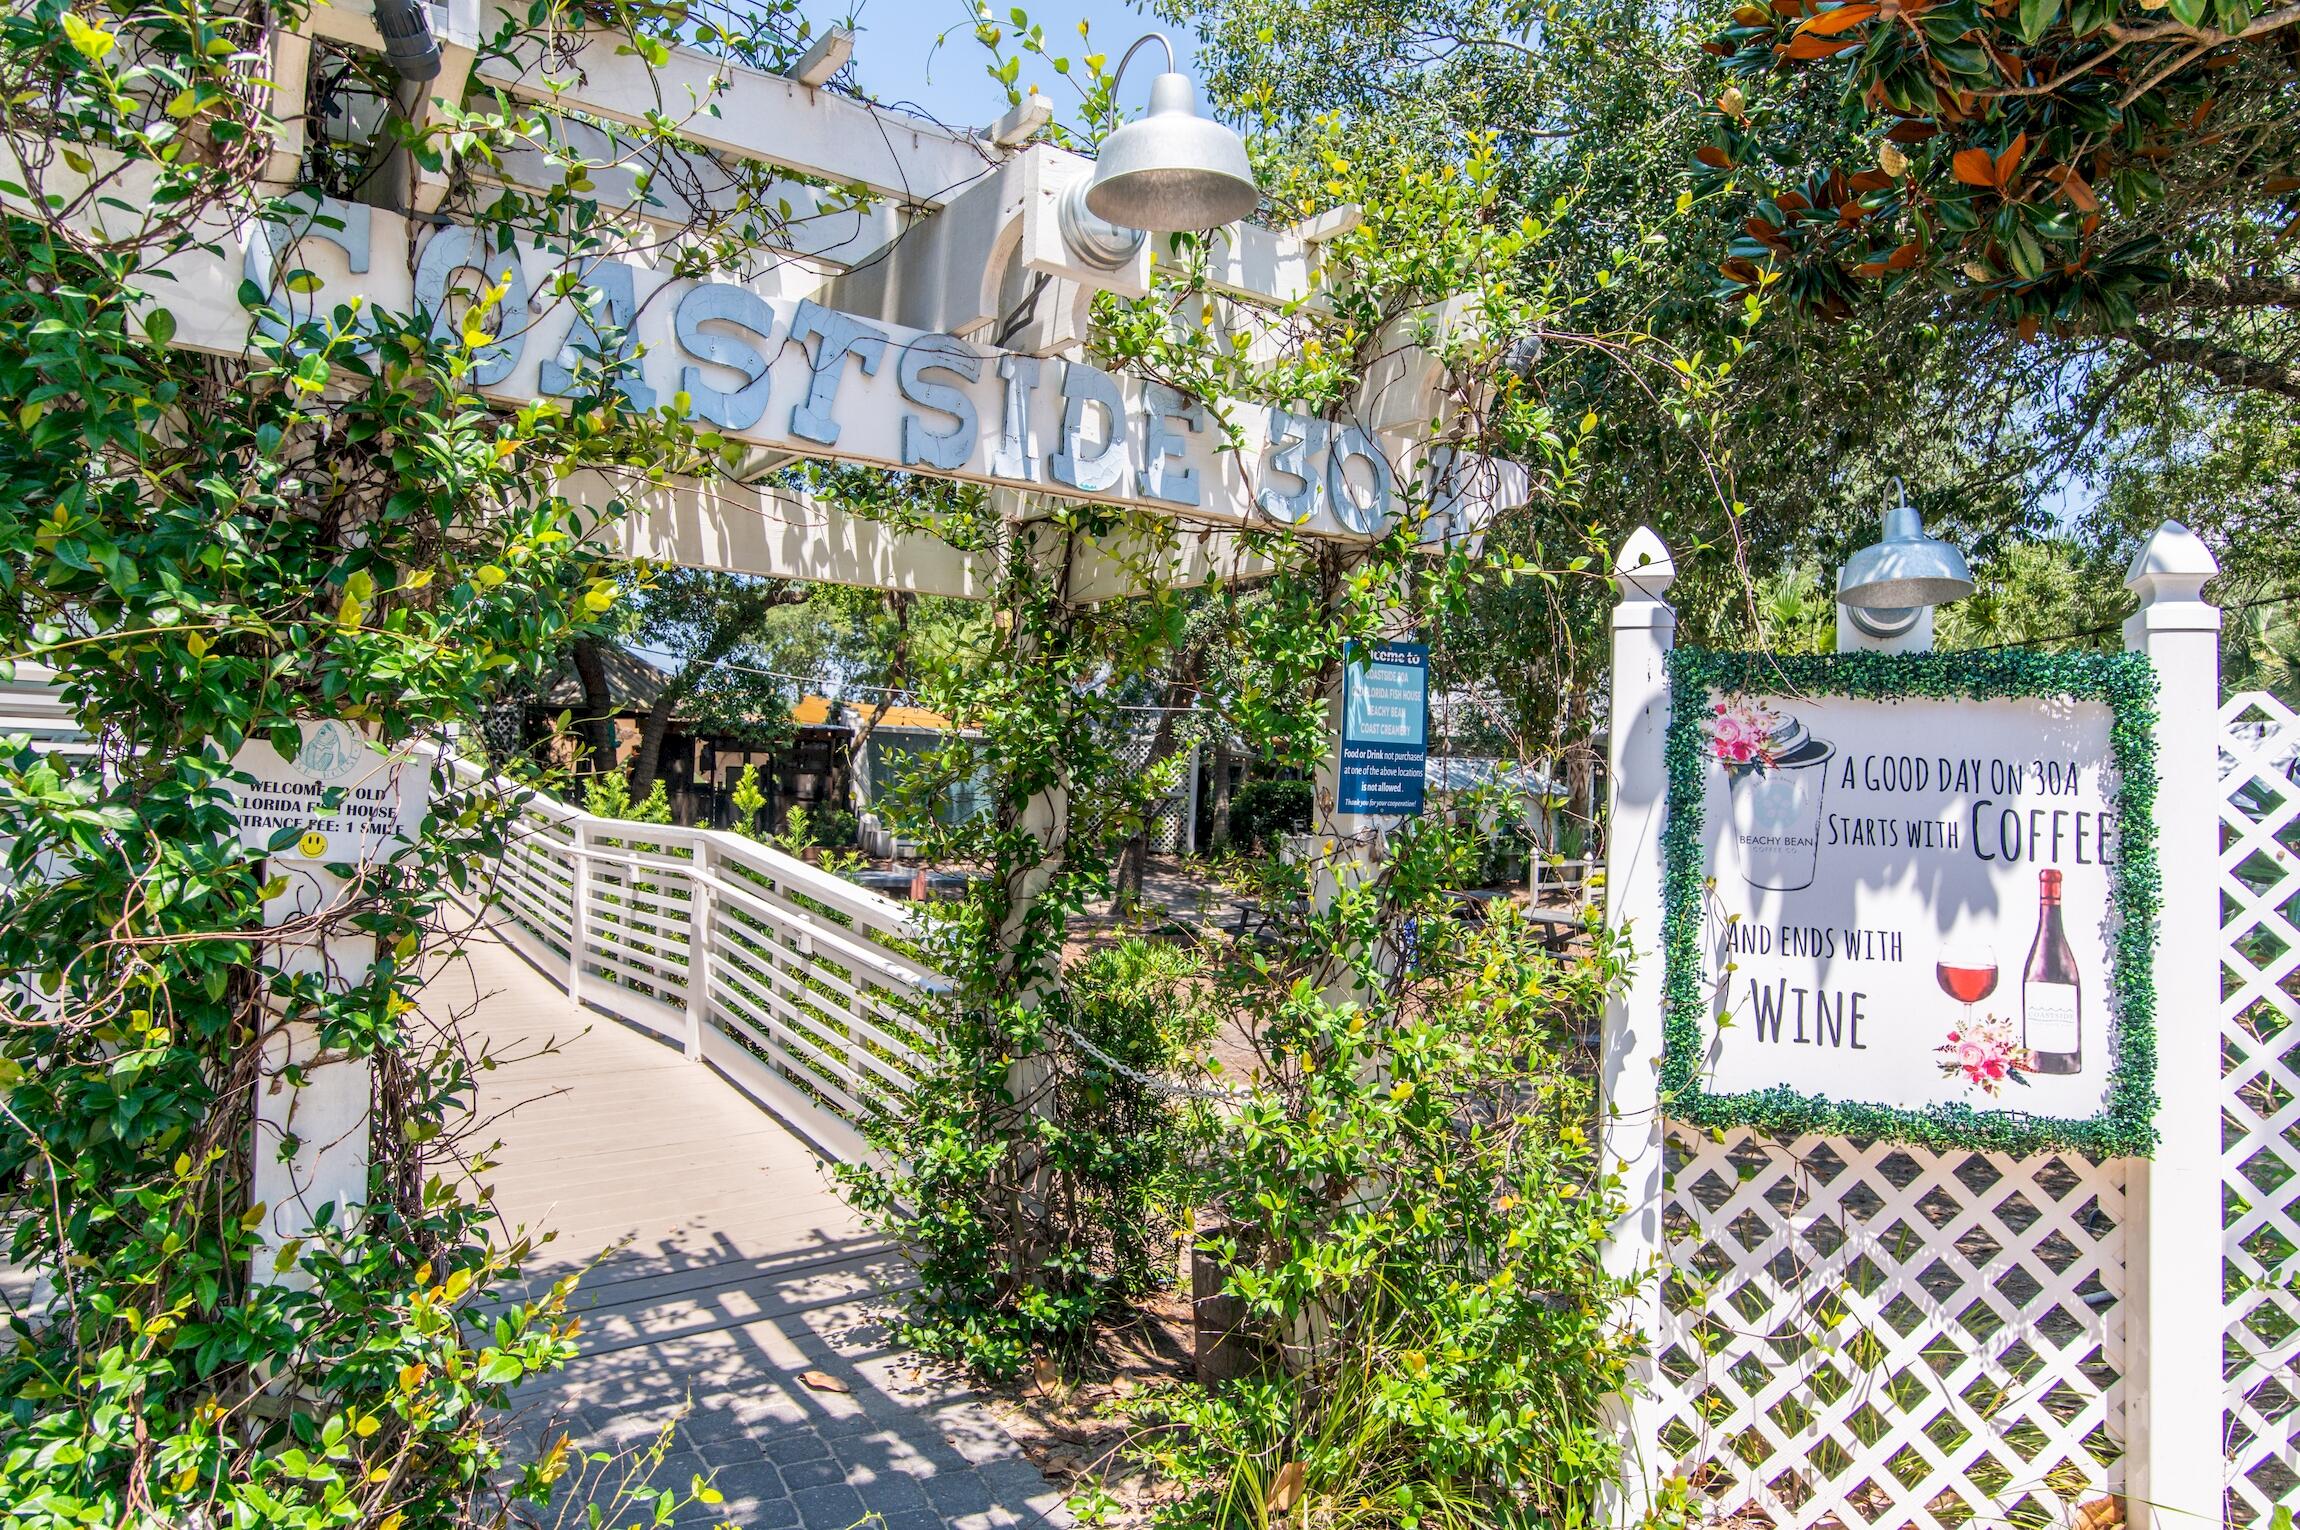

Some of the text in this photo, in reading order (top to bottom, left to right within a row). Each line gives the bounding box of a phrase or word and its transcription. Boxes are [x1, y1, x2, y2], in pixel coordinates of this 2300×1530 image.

[243, 190, 1202, 506] COASTSIDE
[1369, 650, 1420, 664] lcome to
[1365, 687, 1388, 699] LORIDA
[1389, 688, 1402, 699] FISH
[1402, 690, 1421, 701] HOUSE
[1391, 707, 1406, 718] BEAN
[1361, 723, 1411, 736] COAST CREAMERY
[1344, 748, 1359, 758] Food
[1366, 749, 1383, 759] Drink
[1384, 751, 1394, 760] not
[1394, 751, 1424, 762] purchased
[1344, 765, 1424, 778] at one of the above locations
[1841, 755, 2079, 796] A GOOD DAY ON 30A
[1361, 781, 1367, 792] is
[1367, 783, 1378, 792] not
[355, 787, 386, 801] OLD
[238, 796, 301, 813] LORIDA
[346, 804, 397, 819] HOUSE
[1345, 798, 1359, 806] Thank
[1359, 800, 1369, 808] you
[1376, 800, 1387, 808] your
[1387, 800, 1417, 808] cooperation!
[346, 822, 353, 833] 1
[1827, 800, 2114, 866] STARTS WITH COFFEE
[1740, 835, 1813, 847] BEACHY BEAN
[1725, 921, 1903, 962] AND ENDS WITH
[1750, 977, 1867, 1050] WINE
